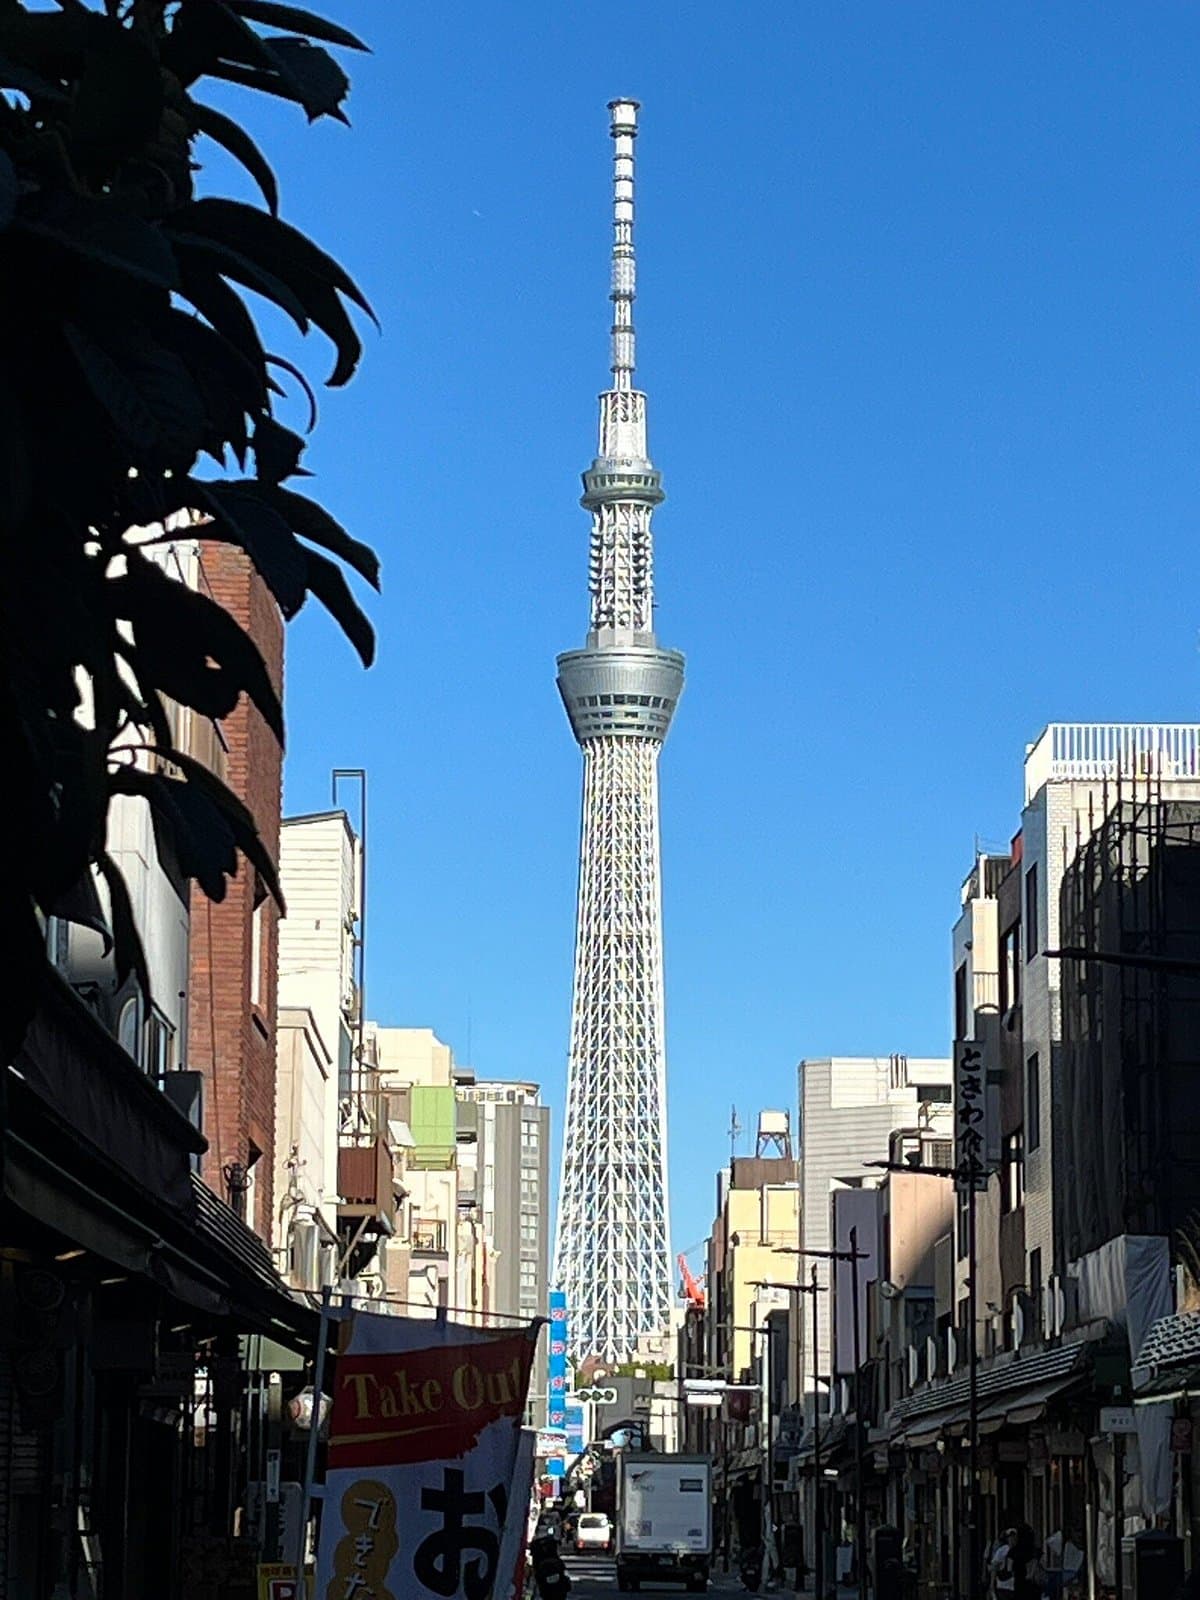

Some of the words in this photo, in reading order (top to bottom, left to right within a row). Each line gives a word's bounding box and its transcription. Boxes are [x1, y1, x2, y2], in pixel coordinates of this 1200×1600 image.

[958, 1047, 985, 1184] ときわ食堂
[341, 1369, 443, 1420] Take
